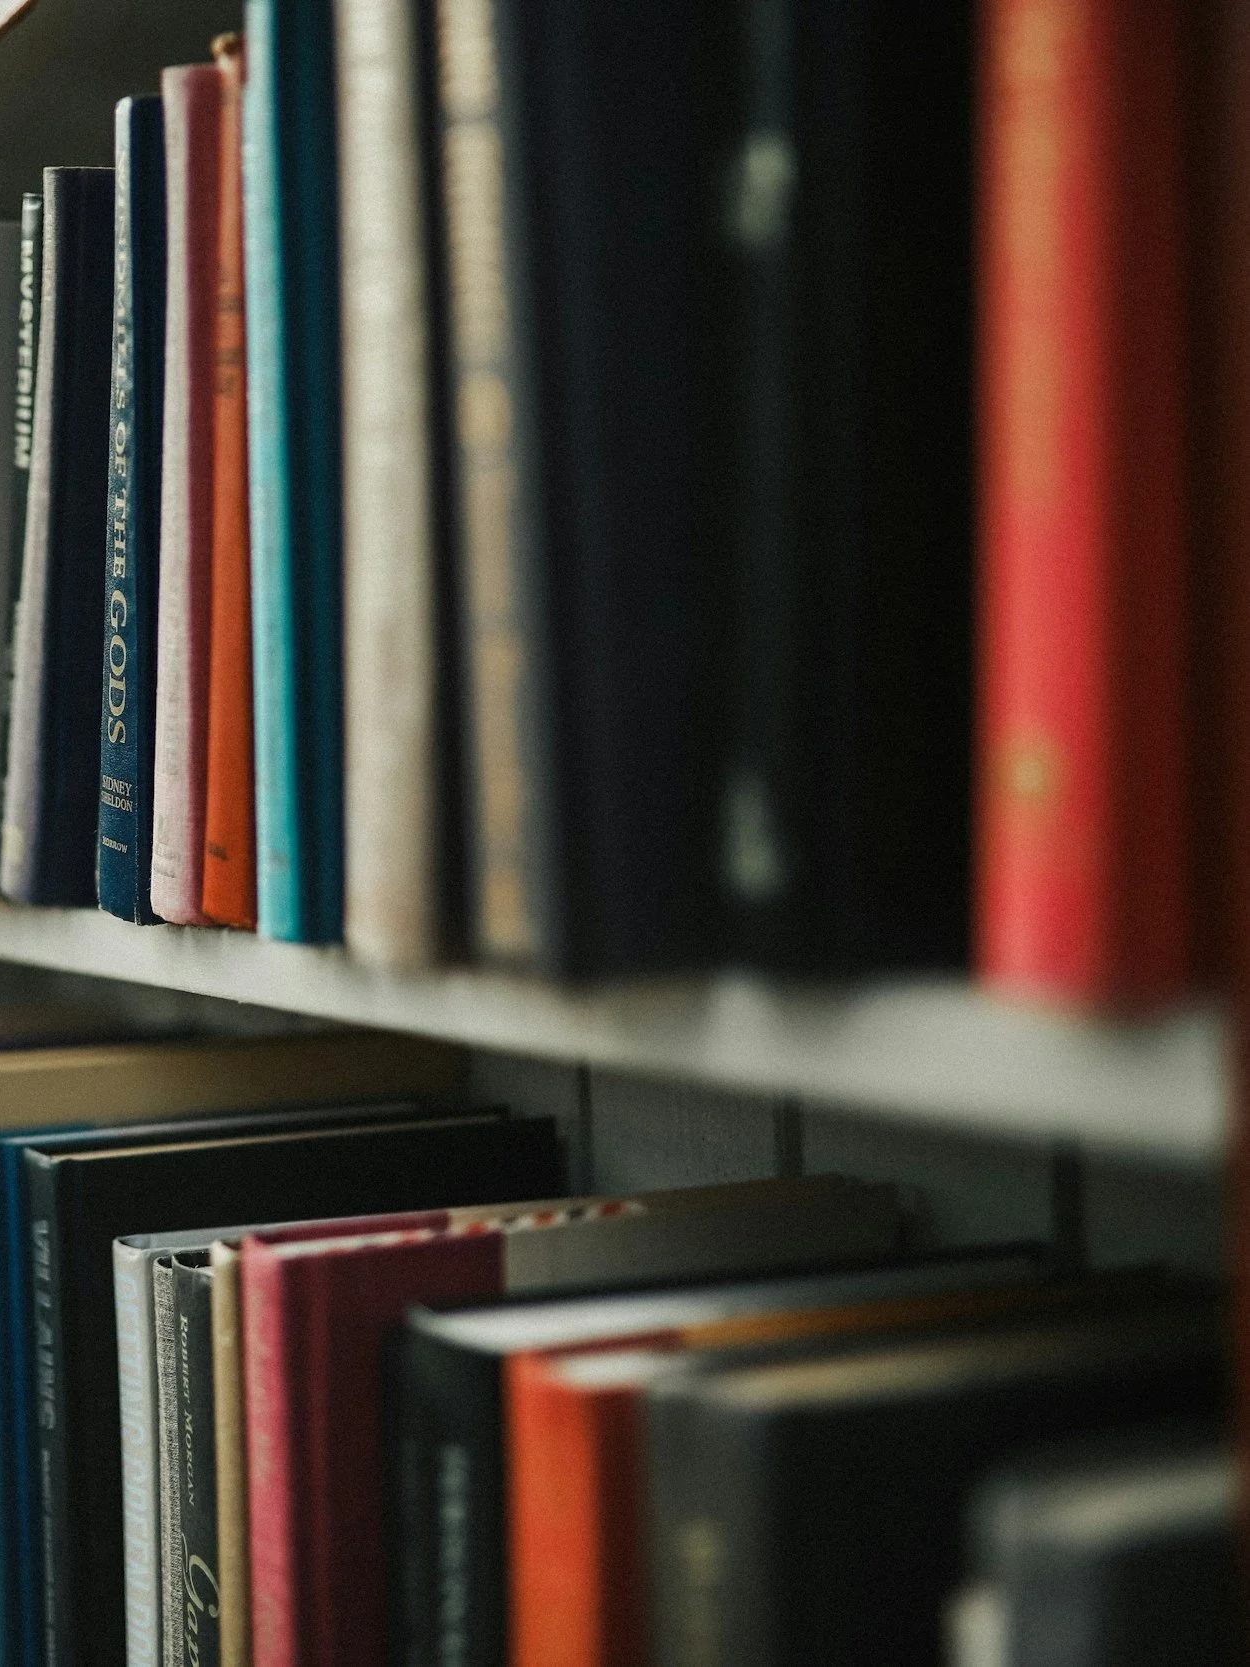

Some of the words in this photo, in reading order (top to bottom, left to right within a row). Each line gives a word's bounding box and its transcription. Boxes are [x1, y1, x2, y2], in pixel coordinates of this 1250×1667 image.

[115, 421, 126, 477] OF
[113, 495, 127, 577] THE
[107, 589, 127, 744] GODS
[101, 790, 133, 813] SHELDON
[102, 774, 132, 797] SIDNEY
[102, 836, 128, 854] MORROW
[180, 1313, 190, 1404] ROBERT
[184, 1409, 195, 1507] MORGAN
